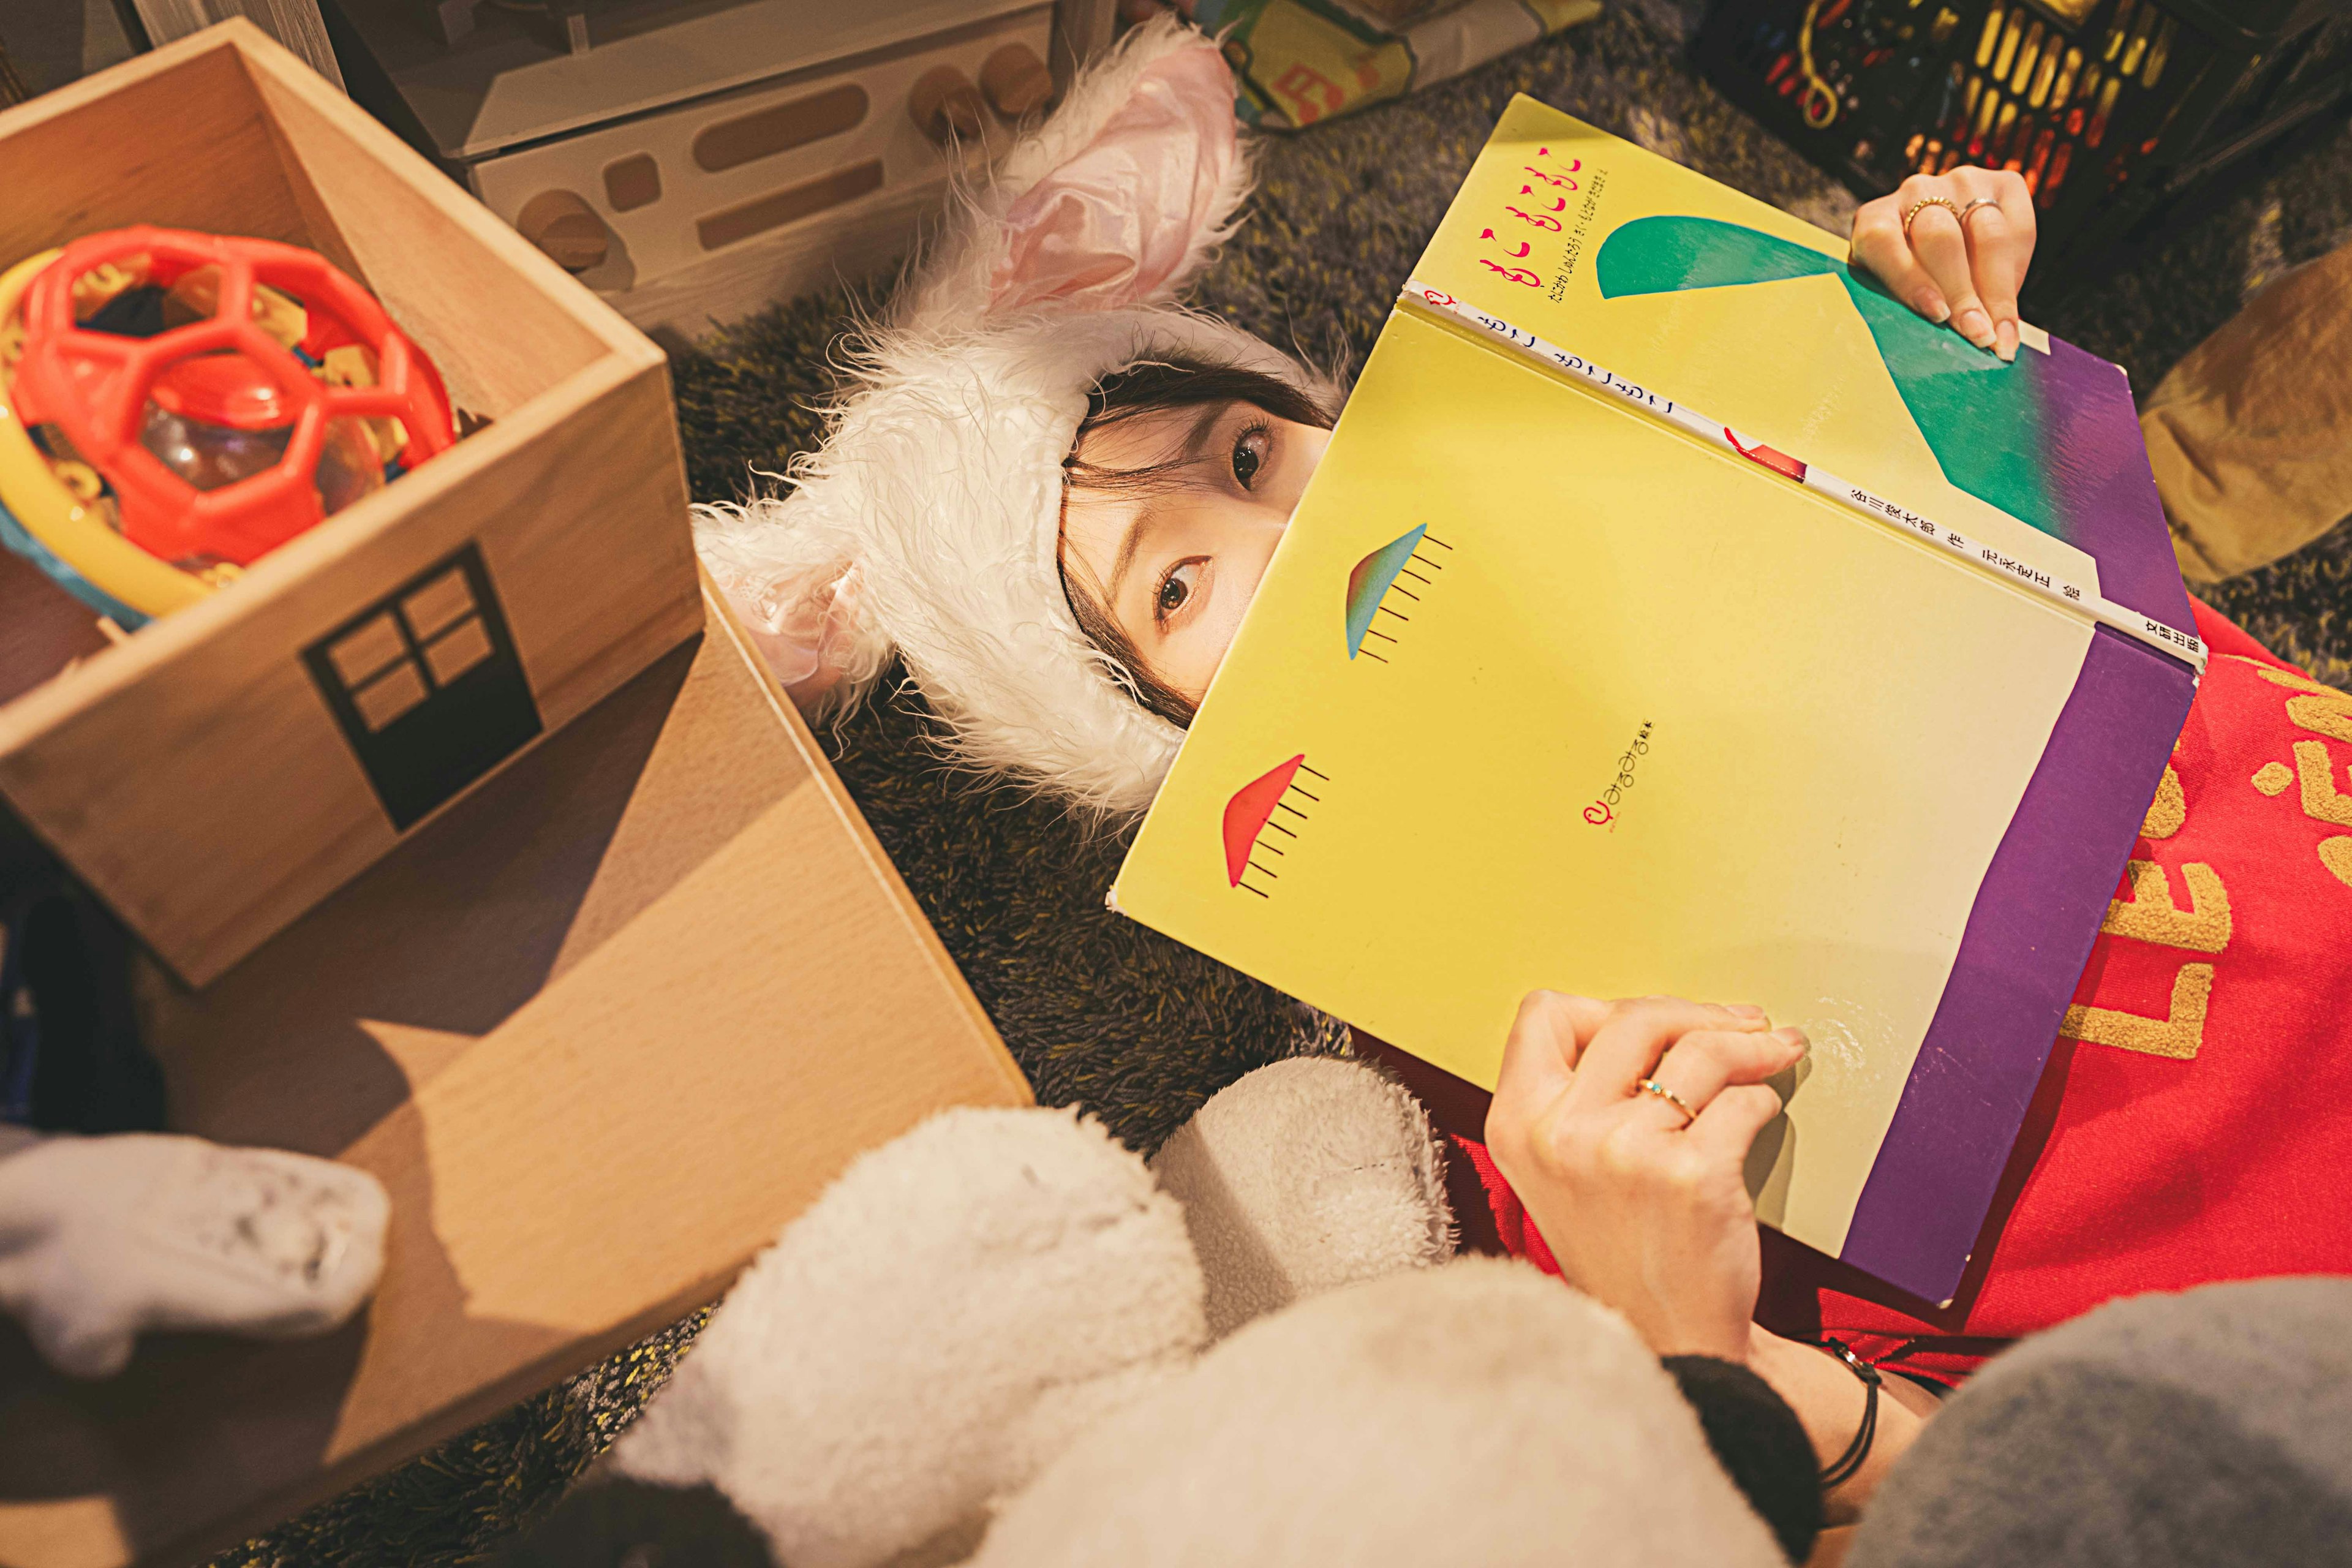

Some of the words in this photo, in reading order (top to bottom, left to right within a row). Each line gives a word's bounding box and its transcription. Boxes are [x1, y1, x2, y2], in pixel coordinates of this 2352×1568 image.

[1506, 147, 1581, 232] もこもこ
[1479, 228, 1540, 287] もこ
[1548, 275, 1569, 303] たにかわ
[1558, 237, 1582, 274] しゅんたろう
[1478, 317, 1535, 347] もこ
[1555, 353, 1673, 413] もこもこ
[1851, 489, 1936, 535] 谷川俊太郎
[1947, 533, 1964, 549] 作
[1982, 549, 2051, 588] 元永定正
[2063, 585, 2081, 600] 絵
[2146, 620, 2199, 653] 文研出版
[1604, 721, 1653, 805] みるみる絵本
